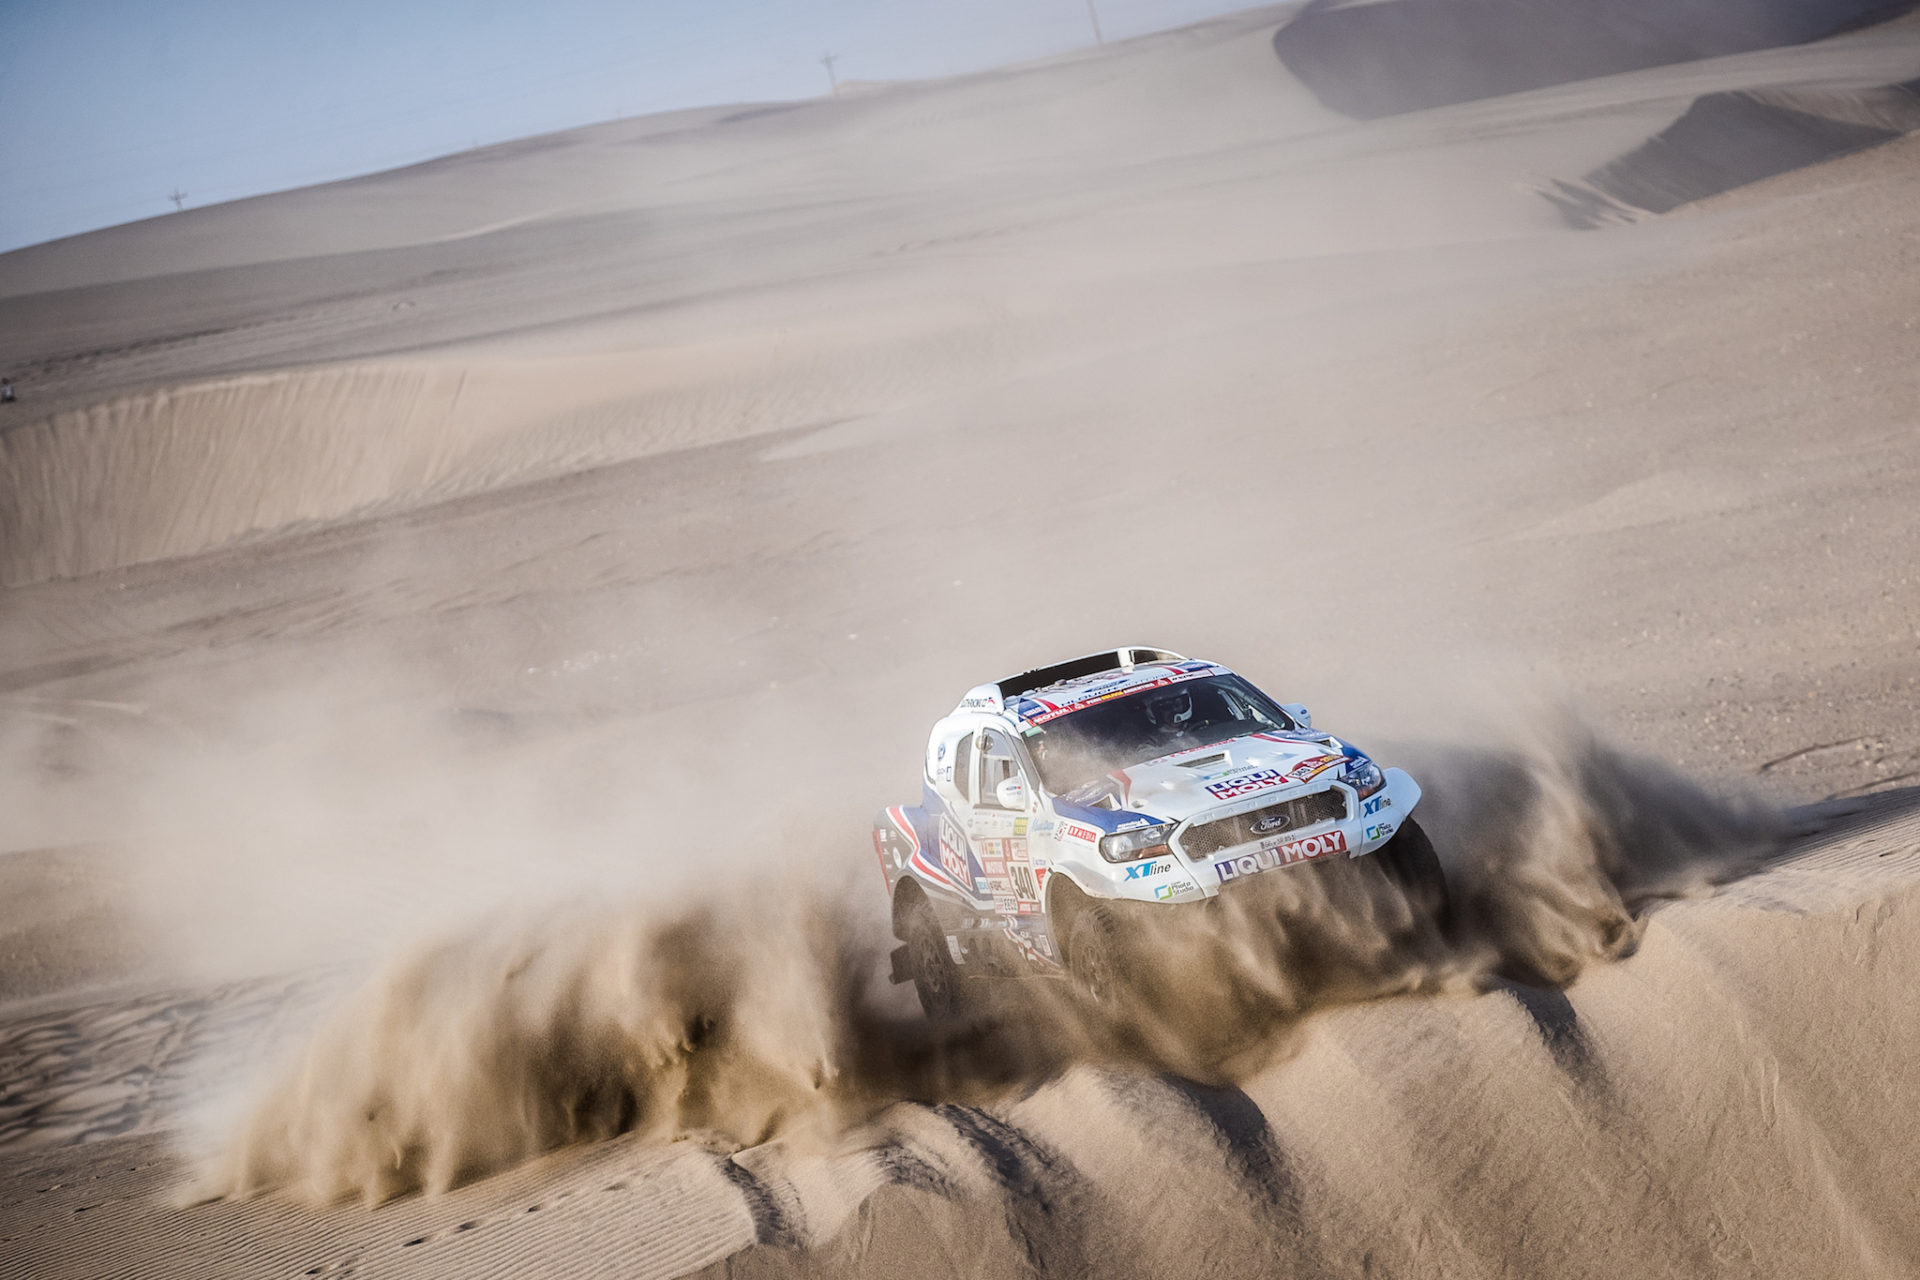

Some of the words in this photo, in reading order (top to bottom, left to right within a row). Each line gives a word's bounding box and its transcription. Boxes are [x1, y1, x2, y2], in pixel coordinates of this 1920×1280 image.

[1033, 706, 1070, 723] MOTUL
[1208, 769, 1280, 791] LIQUI
[1215, 778, 1285, 800] MOLY
[941, 817, 967, 862] LIQUI
[941, 841, 971, 887] MOLY
[1218, 848, 1282, 881] LIQUI
[1281, 831, 1342, 863] MOLY
[1124, 860, 1171, 881] XTline
[1010, 865, 1037, 900] 340
[1172, 881, 1191, 890] Photo
[1173, 886, 1194, 895] Studio
